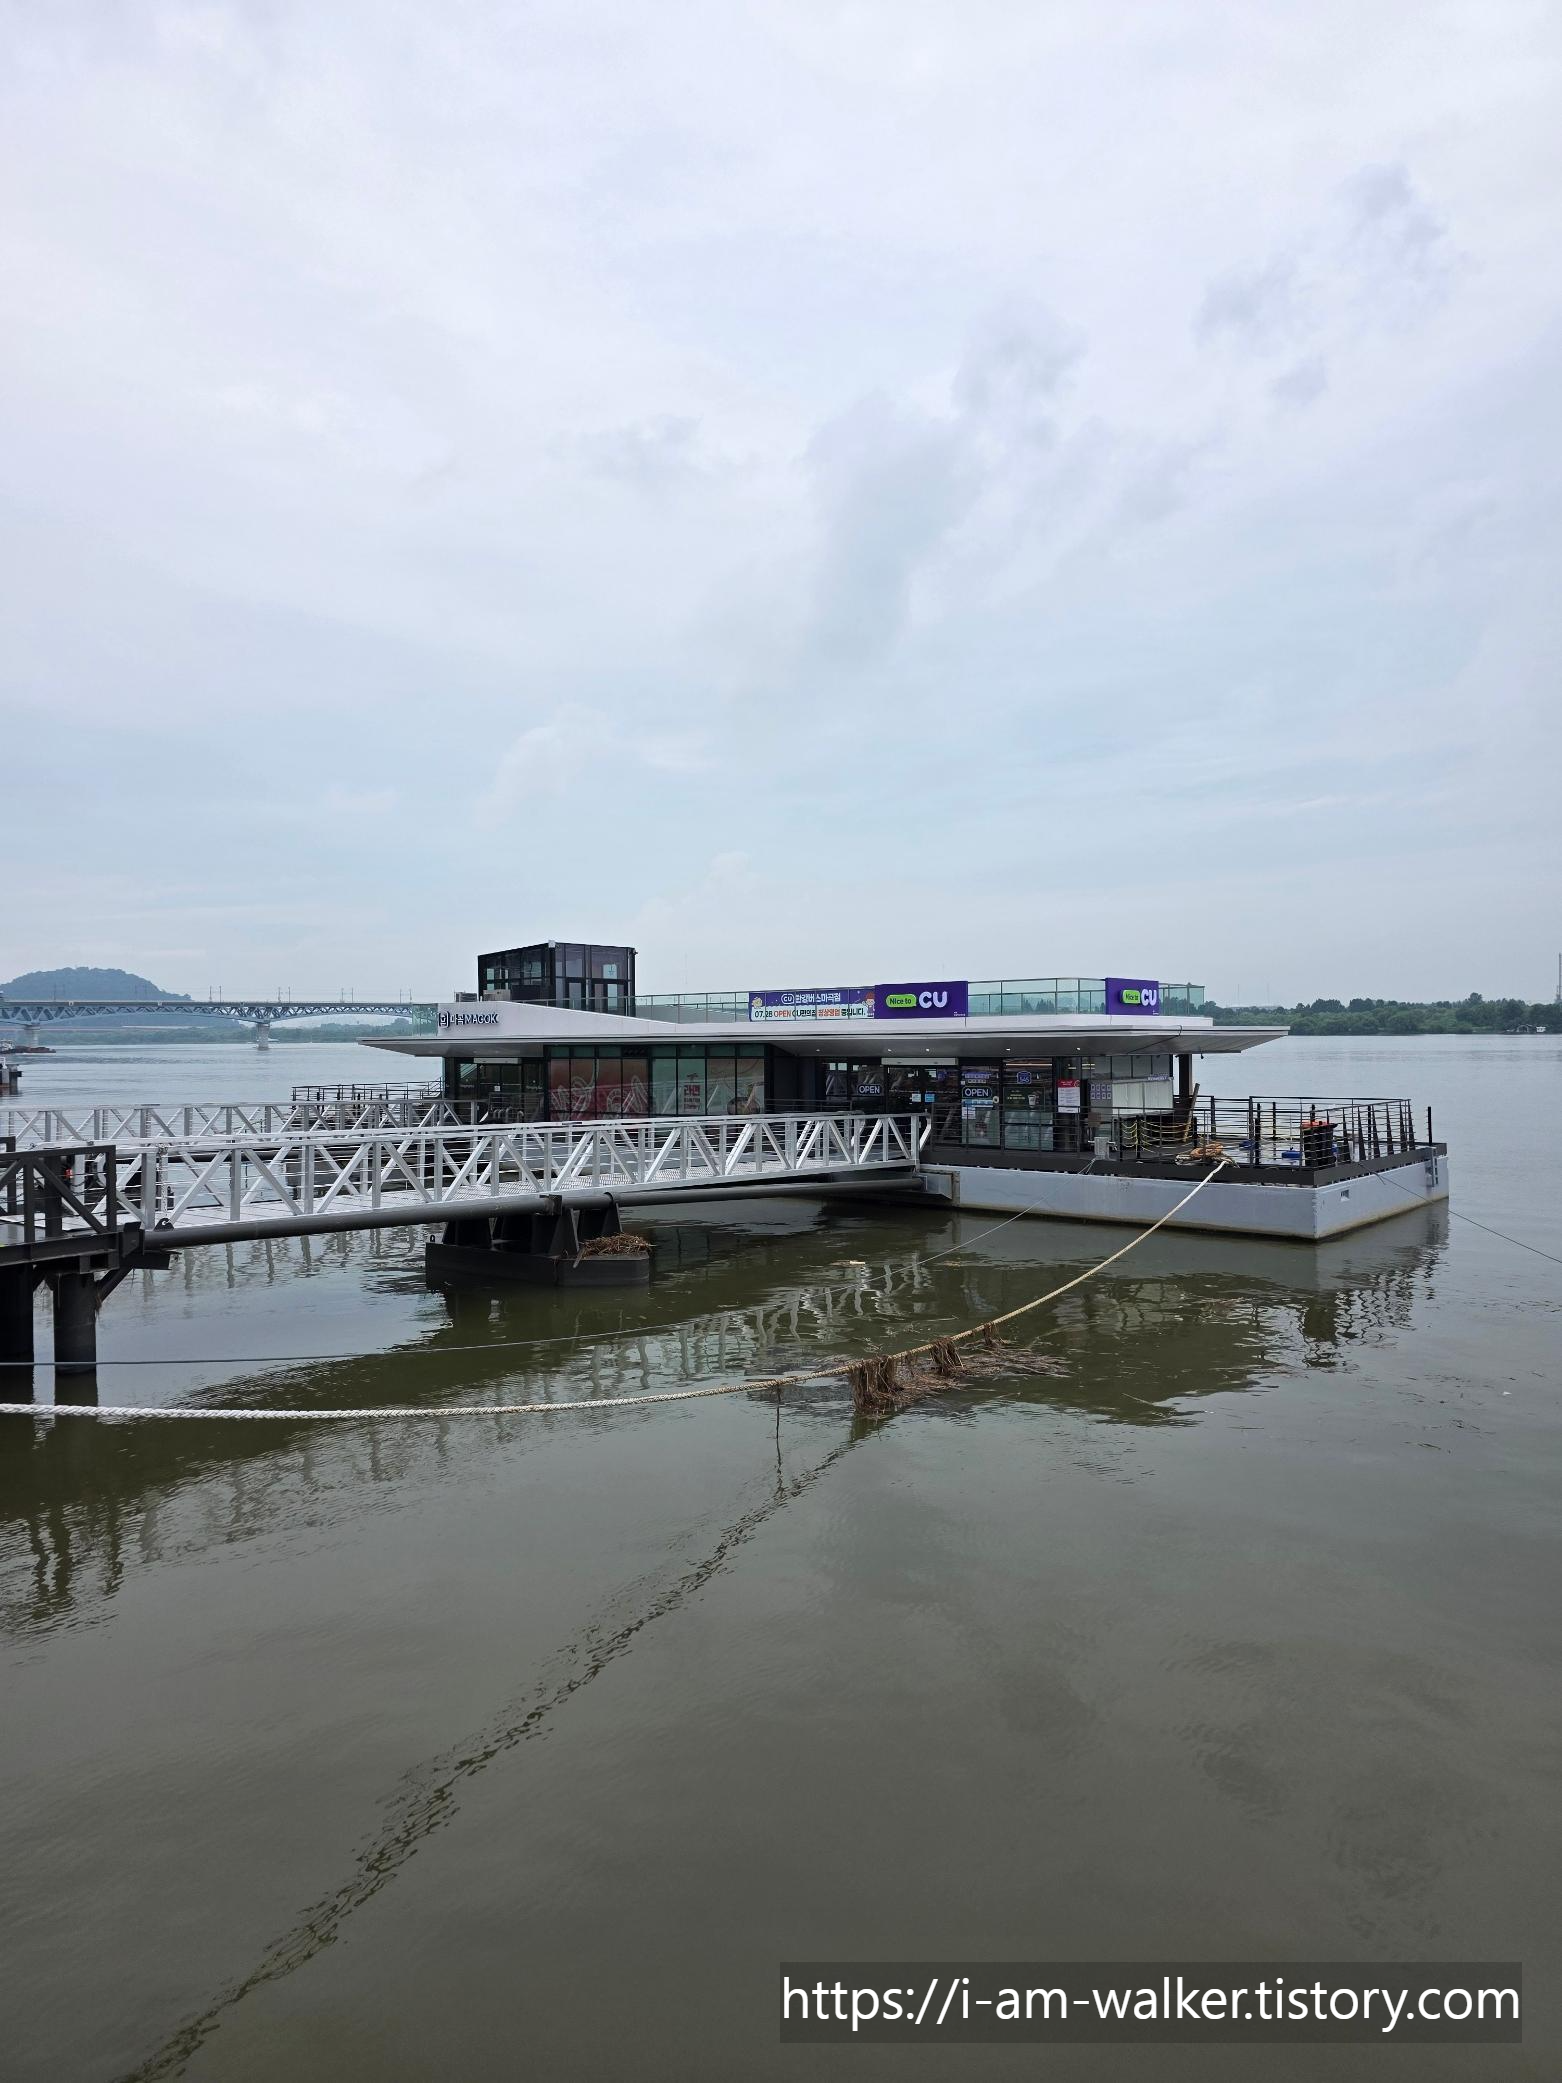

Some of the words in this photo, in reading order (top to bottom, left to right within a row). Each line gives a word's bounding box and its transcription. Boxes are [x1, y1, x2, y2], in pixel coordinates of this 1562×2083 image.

[889, 997, 904, 1005] Nice
[918, 991, 948, 1009] CU
[1141, 988, 1157, 1006] CU
[773, 1010, 791, 1018] OPEN
[465, 1014, 499, 1024] MAGOK
[858, 1085, 880, 1094] OPEN
[964, 1088, 989, 1097] OPEN
